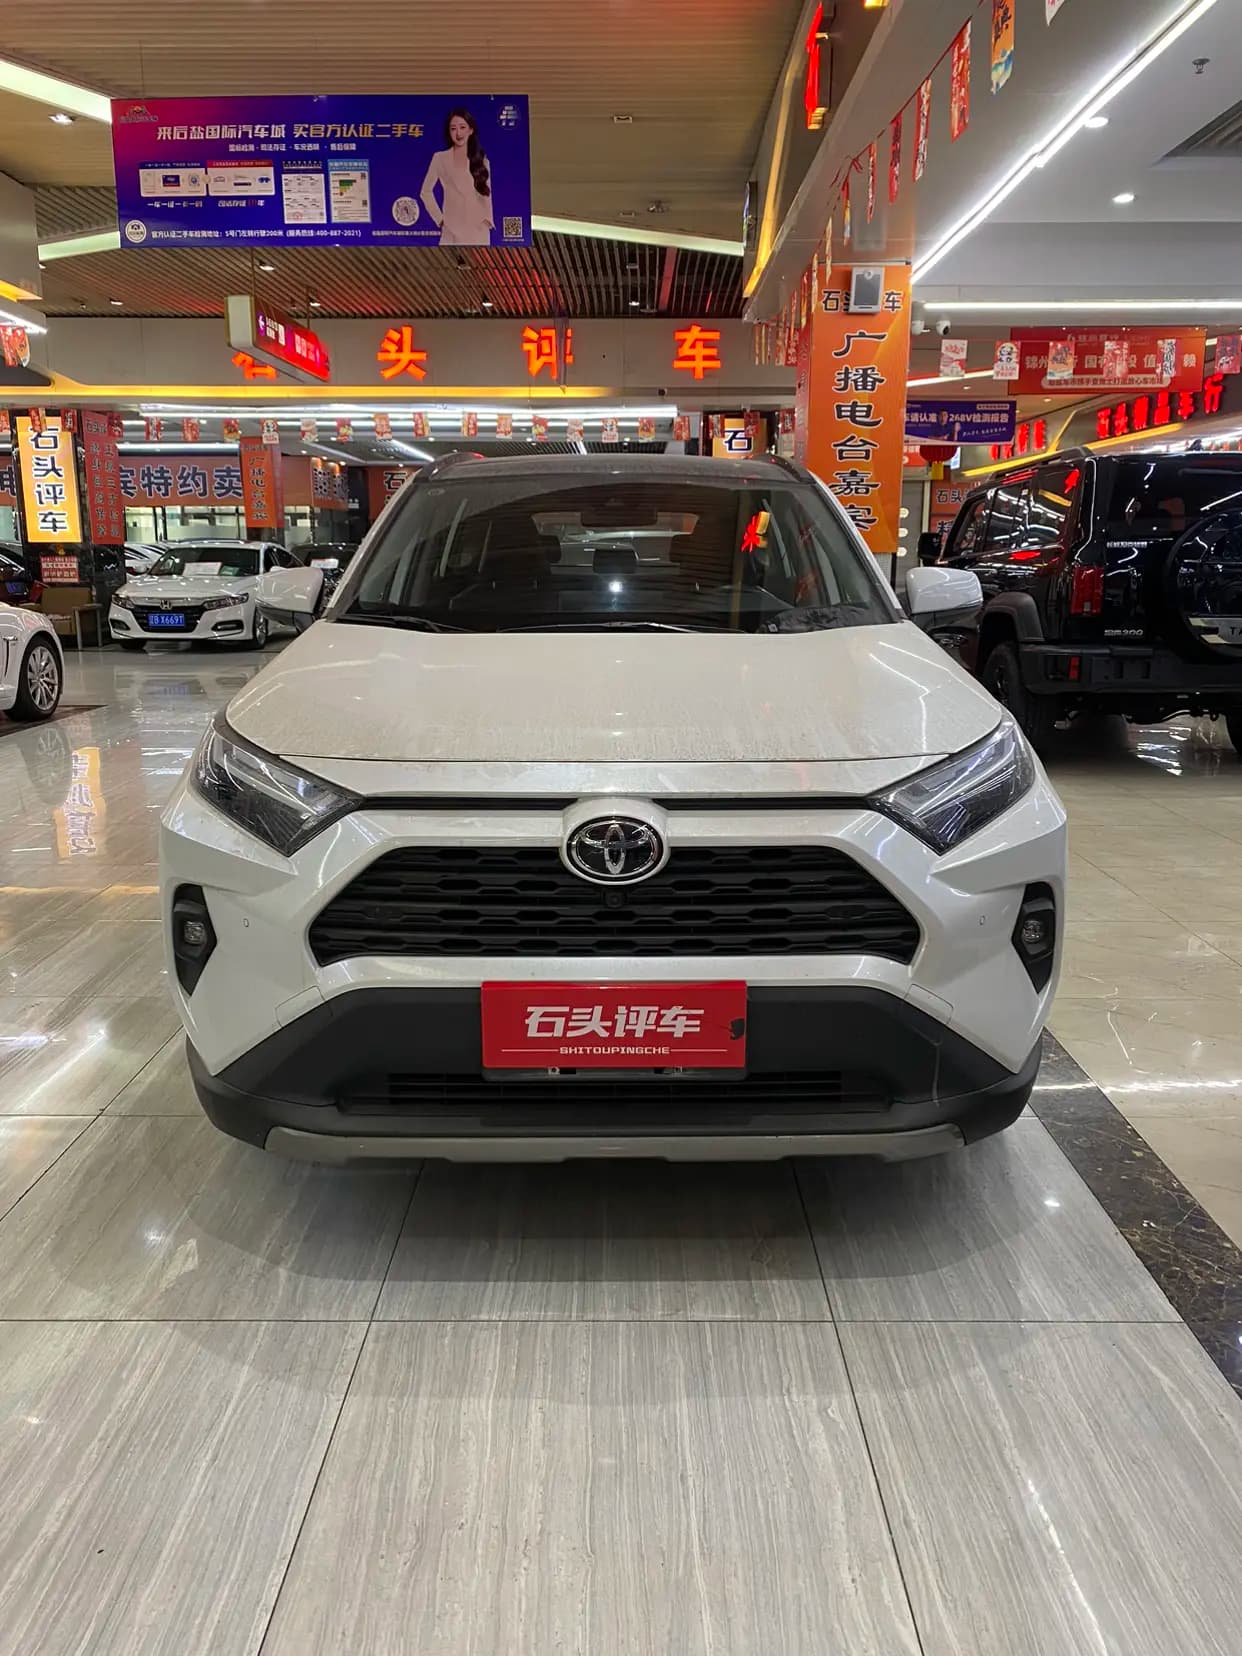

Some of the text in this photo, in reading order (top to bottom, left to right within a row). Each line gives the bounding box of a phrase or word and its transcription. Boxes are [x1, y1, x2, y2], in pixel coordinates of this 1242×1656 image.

[293, 123, 424, 138] 买官方认证二手车
[822, 290, 902, 312] 石车
[29, 427, 68, 533] 石头评车
[936, 489, 970, 504] 石头
[525, 1005, 705, 1038] 石头评车
[559, 1046, 670, 1054] SHITOUPINGCHE
